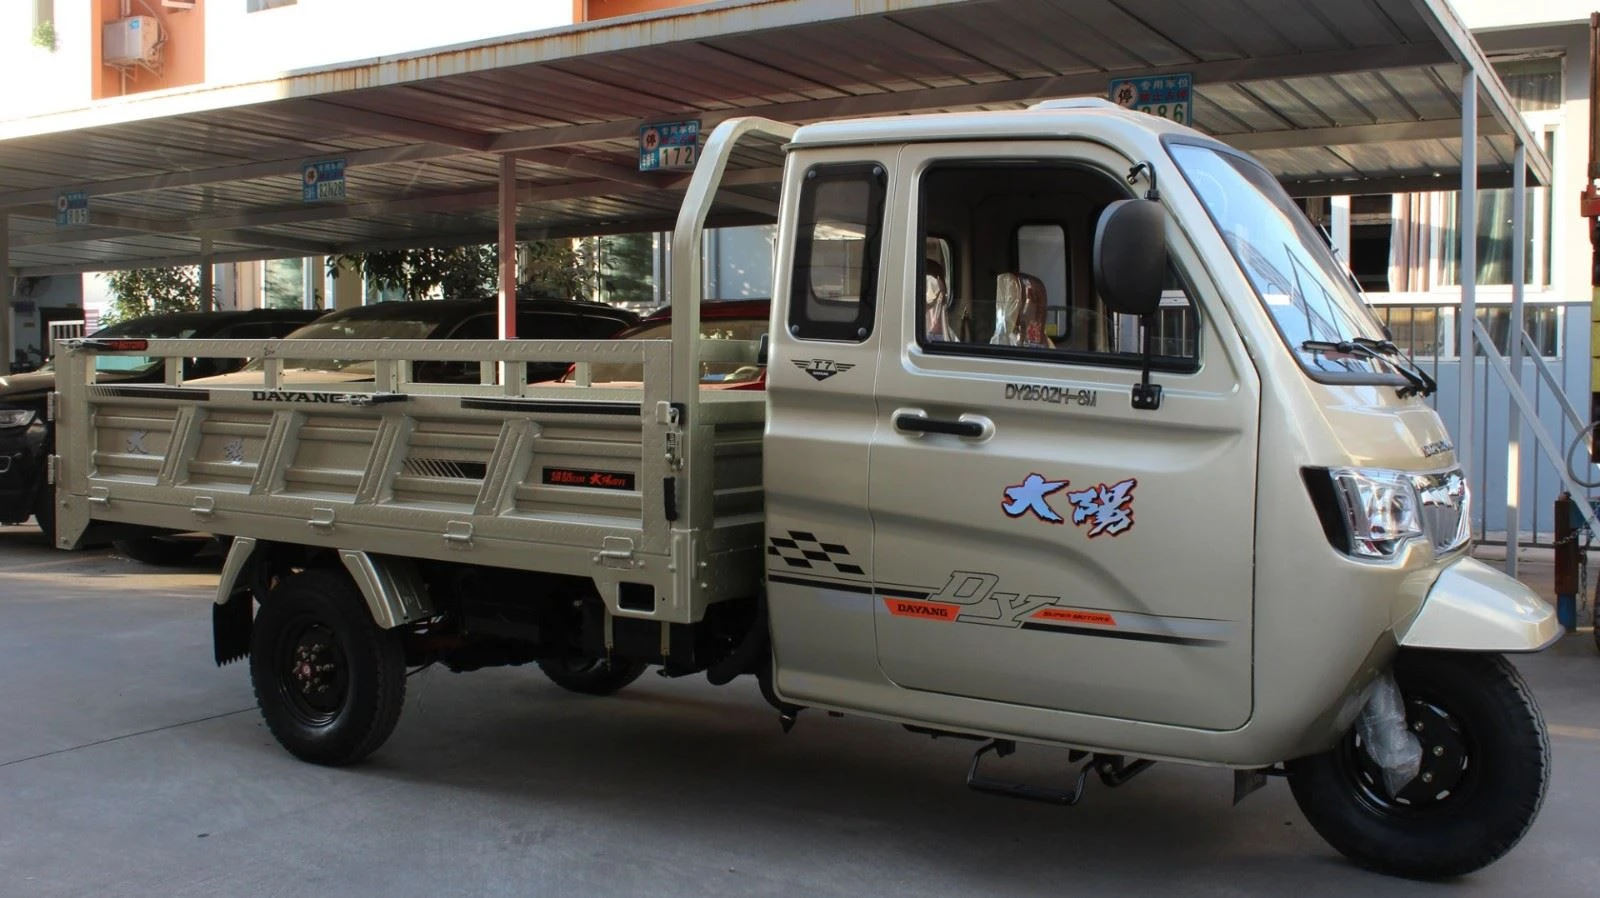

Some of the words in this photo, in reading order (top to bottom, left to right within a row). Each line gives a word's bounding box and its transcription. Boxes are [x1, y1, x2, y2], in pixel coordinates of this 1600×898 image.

[663, 146, 693, 165] 172
[928, 570, 1061, 628] DY
[898, 603, 949, 618] DAYANG
[1075, 613, 1111, 623] MOTORS
